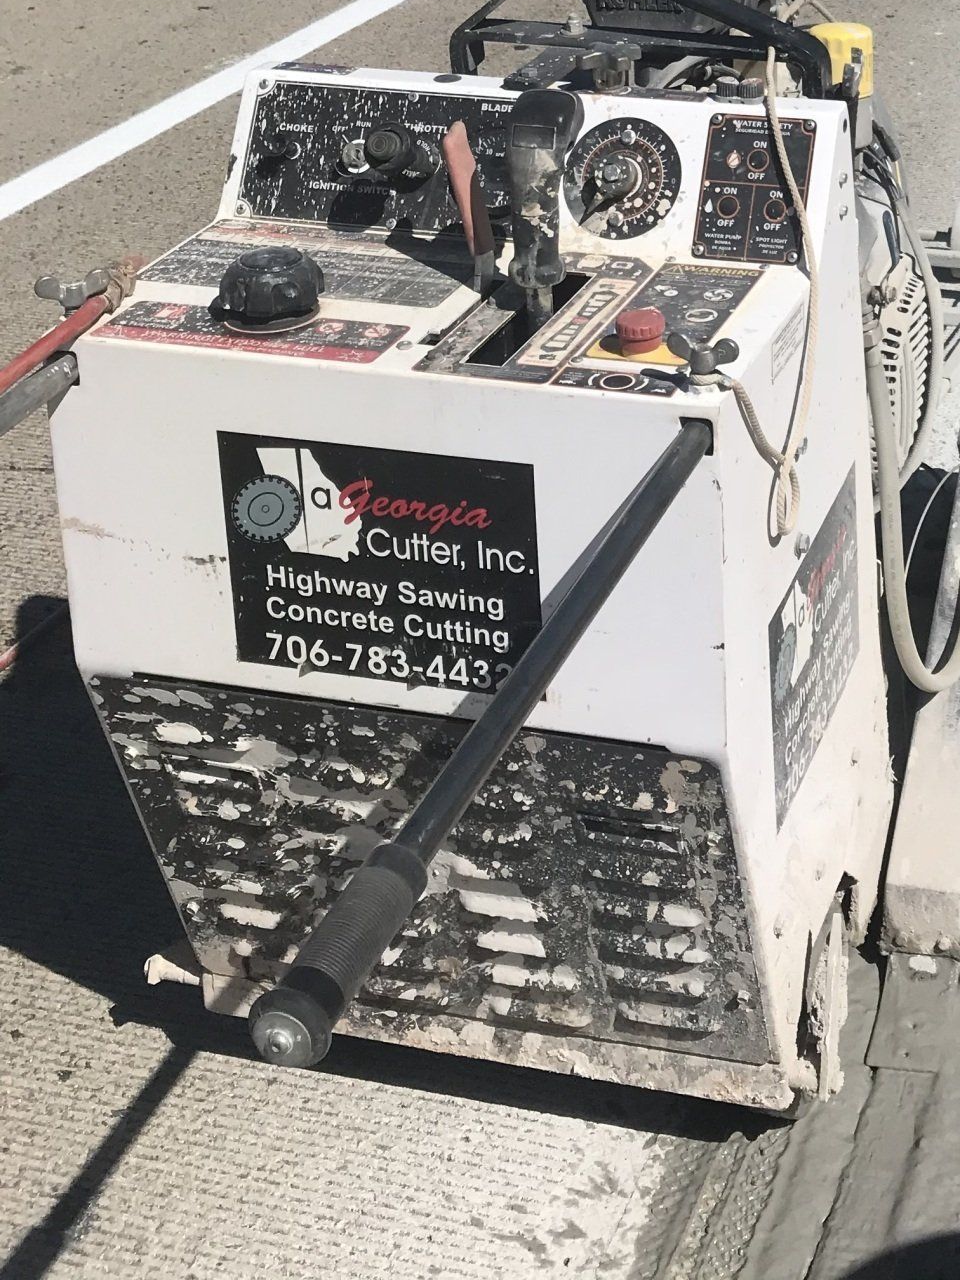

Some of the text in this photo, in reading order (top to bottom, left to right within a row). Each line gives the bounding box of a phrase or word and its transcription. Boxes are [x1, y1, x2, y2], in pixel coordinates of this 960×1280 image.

[280, 123, 314, 133] CHOKE
[404, 122, 449, 134] THROTTL
[735, 120, 762, 128] WATER
[753, 141, 767, 149] ON
[747, 172, 765, 180] OFF
[723, 187, 738, 195] ON
[770, 191, 783, 199] ON
[717, 219, 735, 227] OFF
[763, 222, 781, 231] OFF
[684, 264, 759, 277] WARNING
[311, 479, 492, 535] a Georgia
[366, 528, 534, 575] Cutter, Inc.
[266, 564, 504, 621] Highway Sawing
[266, 596, 509, 653] Concrete Cutting
[784, 591, 850, 738] Highway Sawing
[784, 679, 823, 766] Concrete
